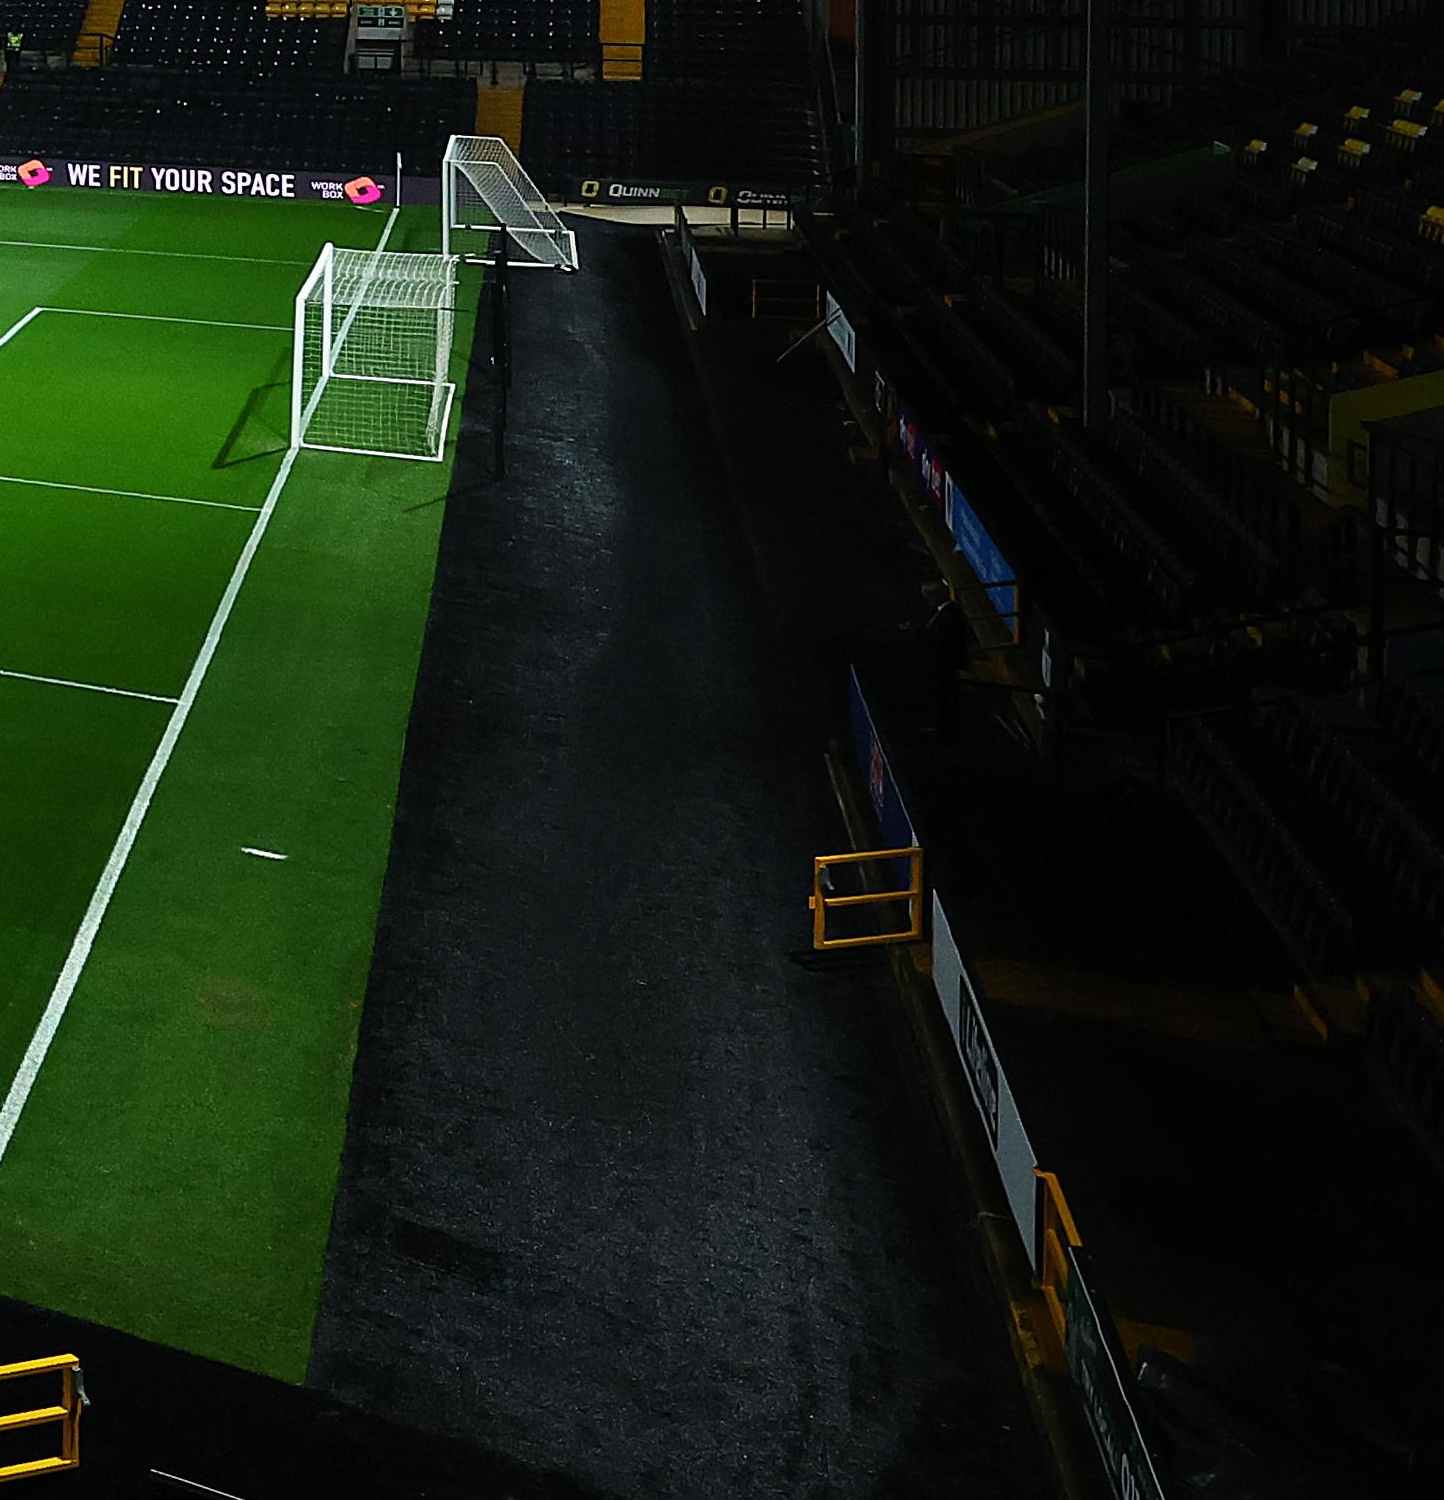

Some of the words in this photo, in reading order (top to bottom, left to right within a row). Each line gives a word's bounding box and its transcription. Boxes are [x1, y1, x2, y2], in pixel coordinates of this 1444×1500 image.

[67, 163, 101, 187] WE
[109, 164, 143, 189] FIT
[151, 166, 212, 194] YOUR
[221, 171, 296, 198] SPACE
[311, 181, 344, 191] WORK
[322, 190, 344, 199] BOX
